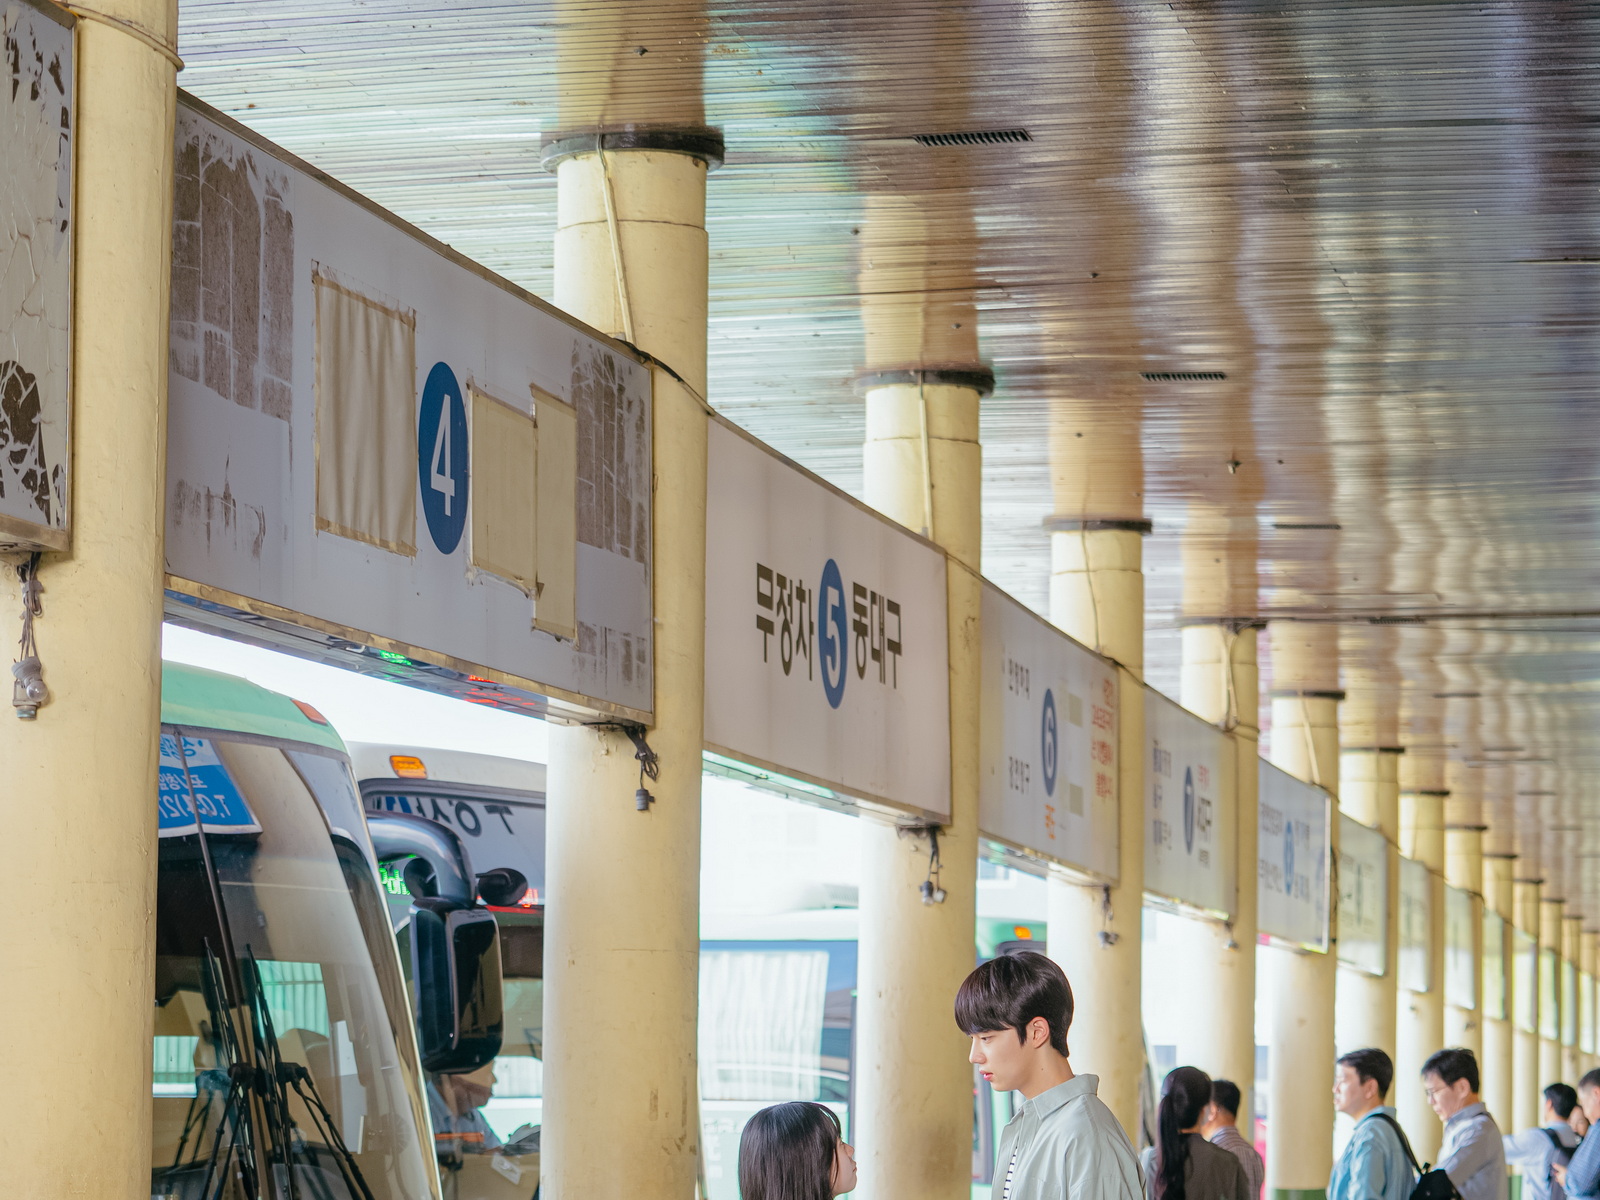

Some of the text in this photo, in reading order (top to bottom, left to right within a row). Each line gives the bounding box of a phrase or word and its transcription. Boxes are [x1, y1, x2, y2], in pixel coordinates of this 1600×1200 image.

[429, 393, 456, 517] 4
[756, 562, 902, 690] 무정차 5 동대구
[1044, 706, 1055, 779] 6
